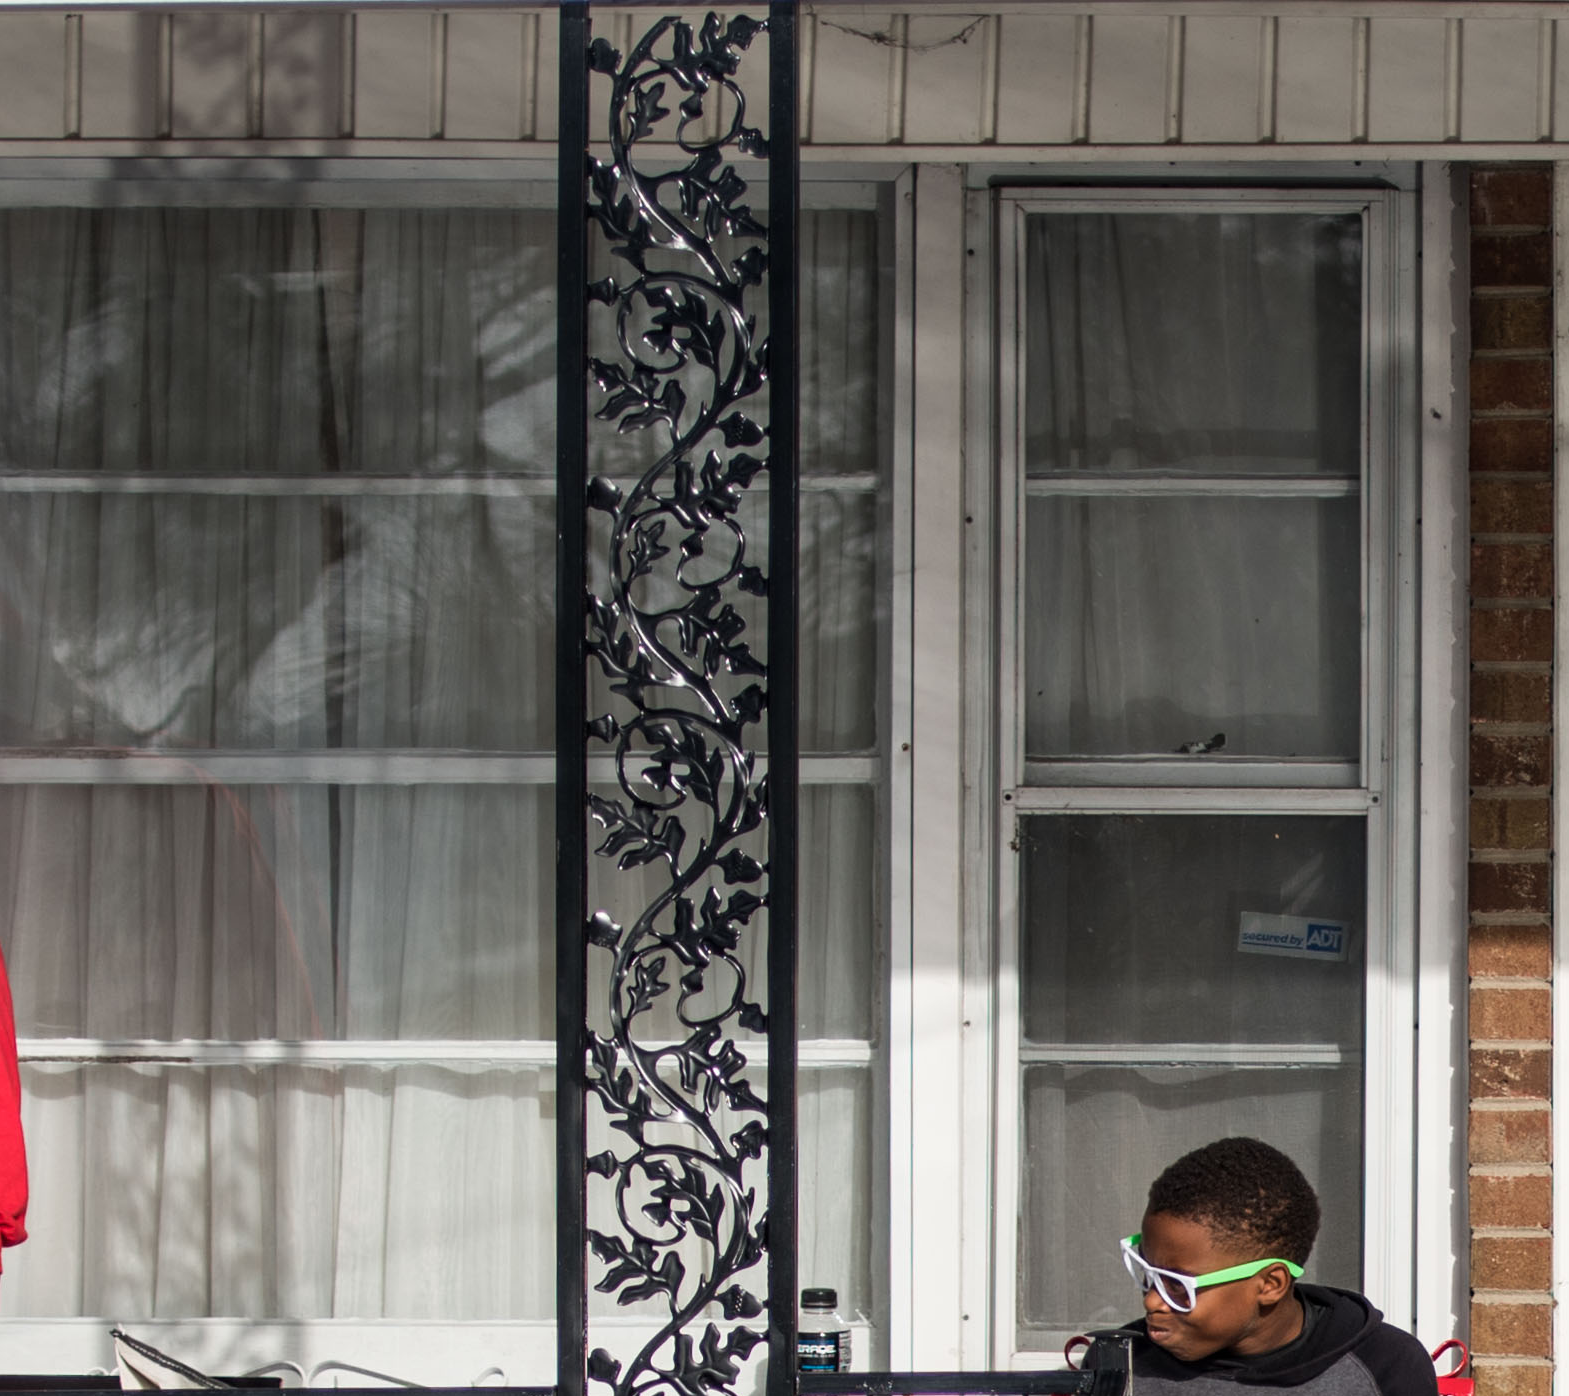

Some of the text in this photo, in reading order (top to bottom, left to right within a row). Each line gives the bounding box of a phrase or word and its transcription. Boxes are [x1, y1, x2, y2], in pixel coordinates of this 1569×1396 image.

[1242, 931, 1304, 946] secured by
[1307, 928, 1341, 949] ADT
